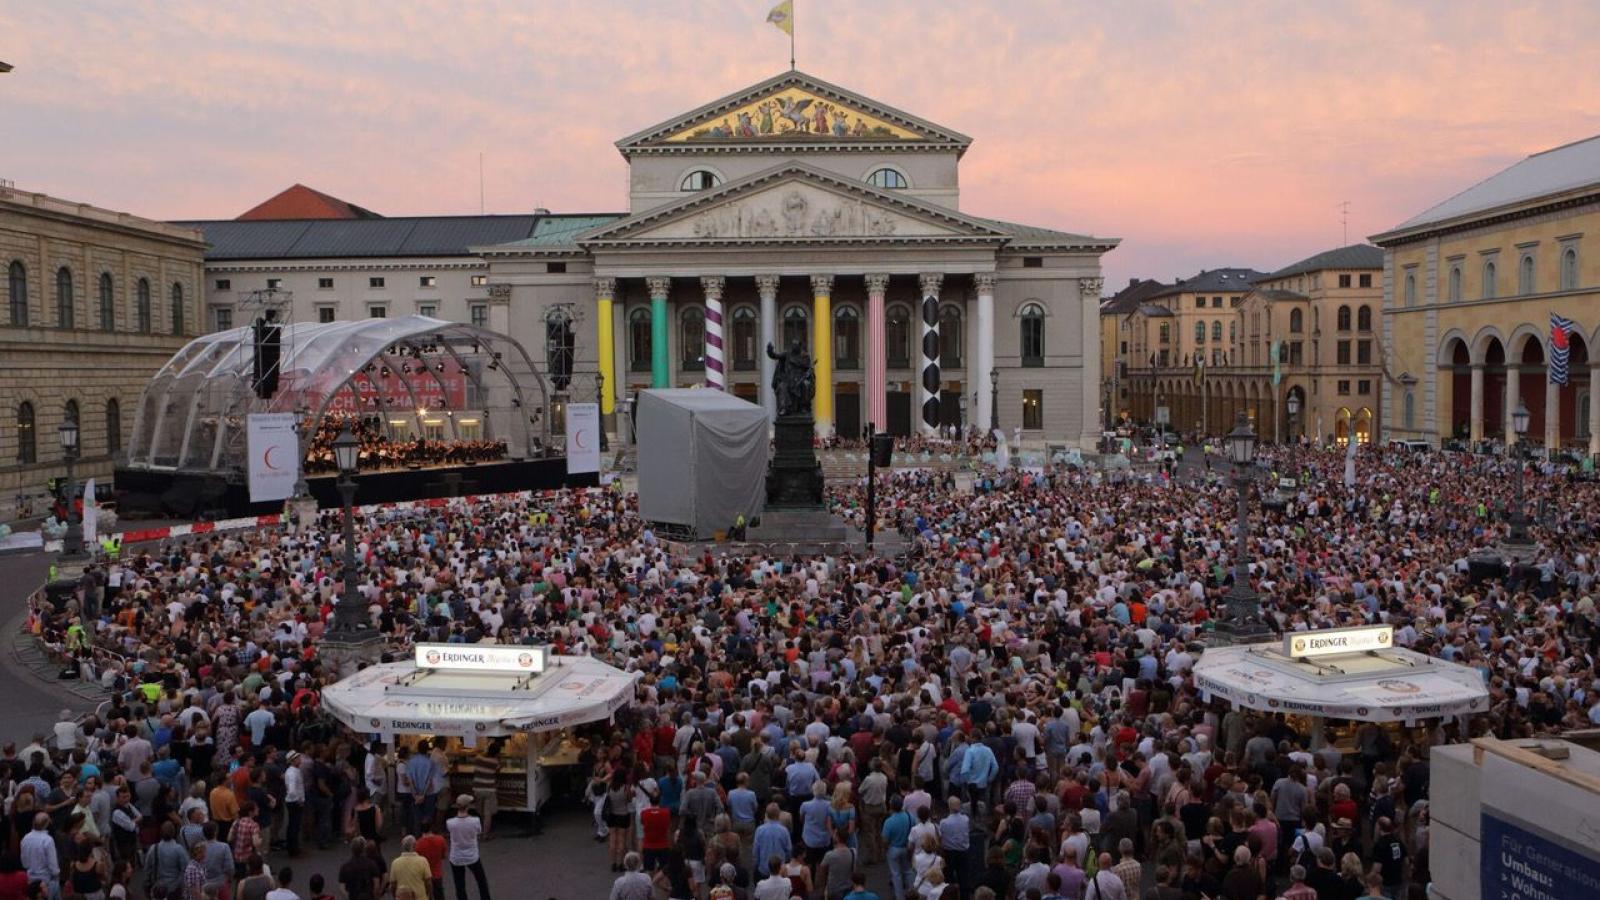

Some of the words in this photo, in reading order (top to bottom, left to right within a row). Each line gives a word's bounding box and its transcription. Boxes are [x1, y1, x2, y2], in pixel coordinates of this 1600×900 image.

[1310, 637, 1349, 650] ERDINGER
[442, 652, 487, 665] ERDINGER
[1284, 701, 1323, 713] ERDINGER
[391, 719, 433, 731] ERDINGER
[1502, 851, 1553, 887] Umbau:
